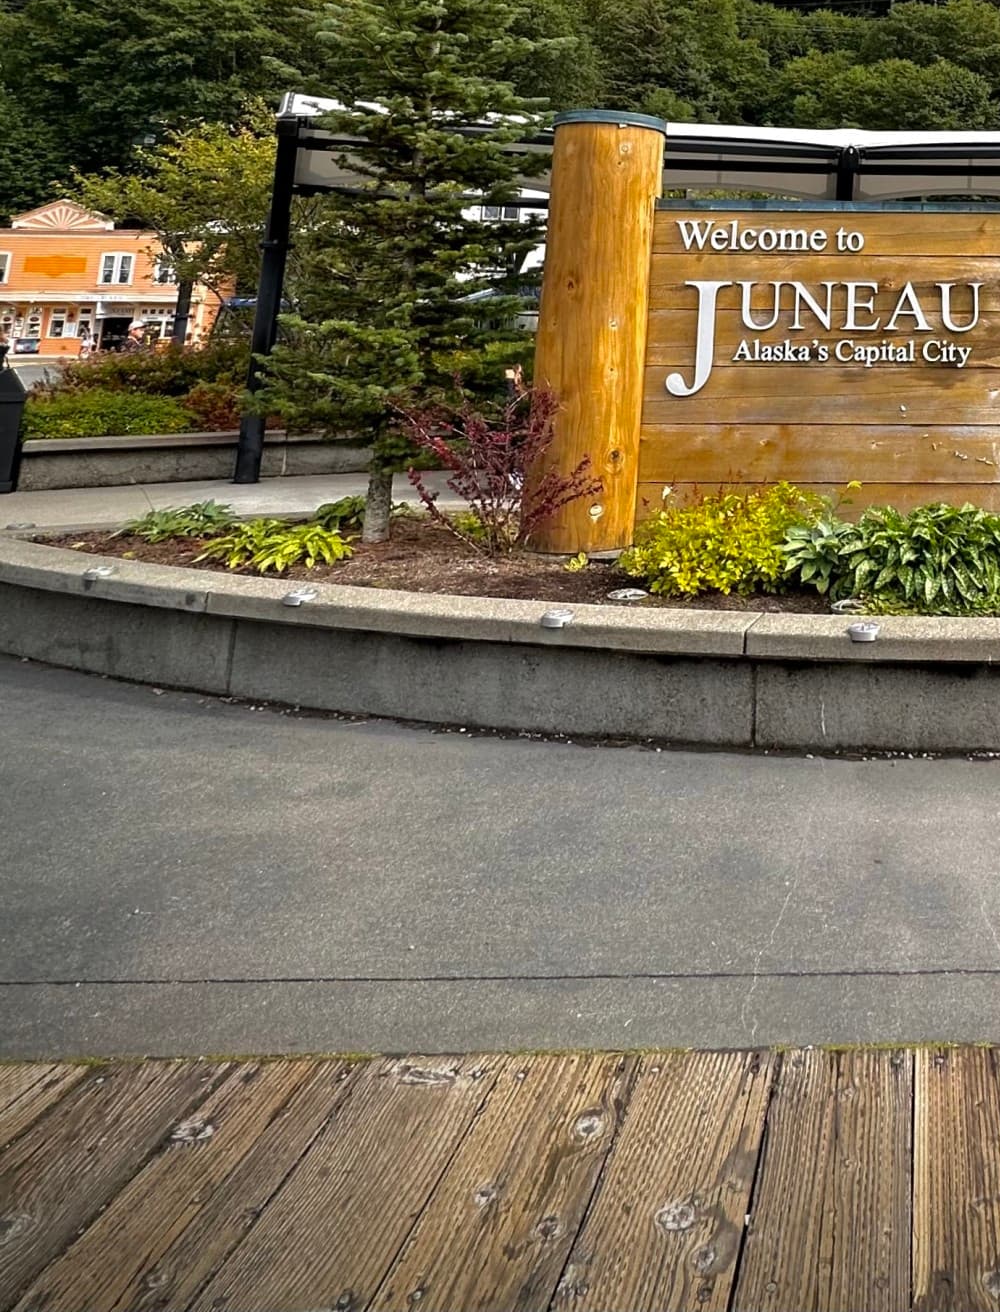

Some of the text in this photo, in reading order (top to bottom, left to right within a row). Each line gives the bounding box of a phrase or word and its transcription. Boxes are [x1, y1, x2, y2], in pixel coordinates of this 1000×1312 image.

[676, 220, 864, 252] Welcome to
[665, 280, 984, 396] JUNEAU
[732, 339, 972, 368] Alaska's Capital City
